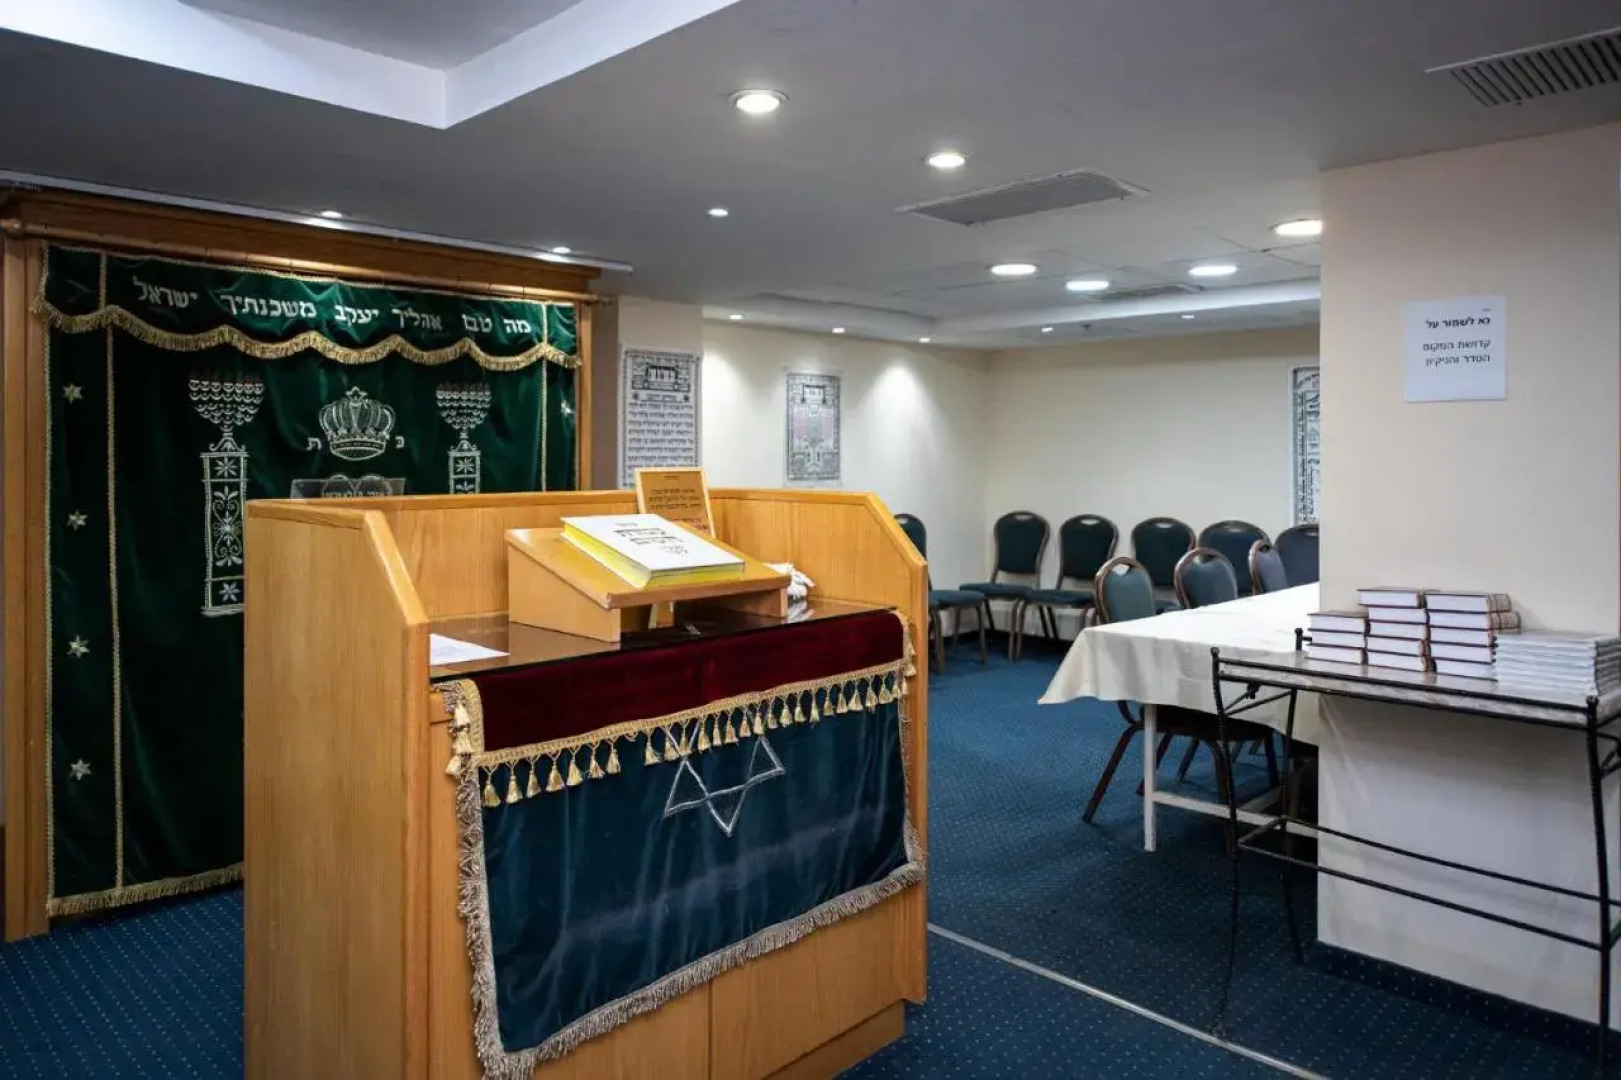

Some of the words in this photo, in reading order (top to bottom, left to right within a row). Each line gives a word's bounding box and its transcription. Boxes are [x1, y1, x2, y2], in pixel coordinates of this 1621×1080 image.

[132, 274, 199, 309] ישראל
[219, 294, 317, 319] משכנתיך
[333, 304, 380, 327] יעקב
[391, 307, 443, 330] אהליך
[1477, 317, 1491, 325] נא
[503, 317, 532, 334] מה
[1425, 319, 1439, 329] על
[1441, 316, 1475, 328] לשמור
[1422, 341, 1455, 352] המקום
[1457, 339, 1491, 350] קדושת
[1425, 355, 1460, 367] והניקיון
[1463, 354, 1491, 363] הסדר
[306, 437, 322, 451] ת
